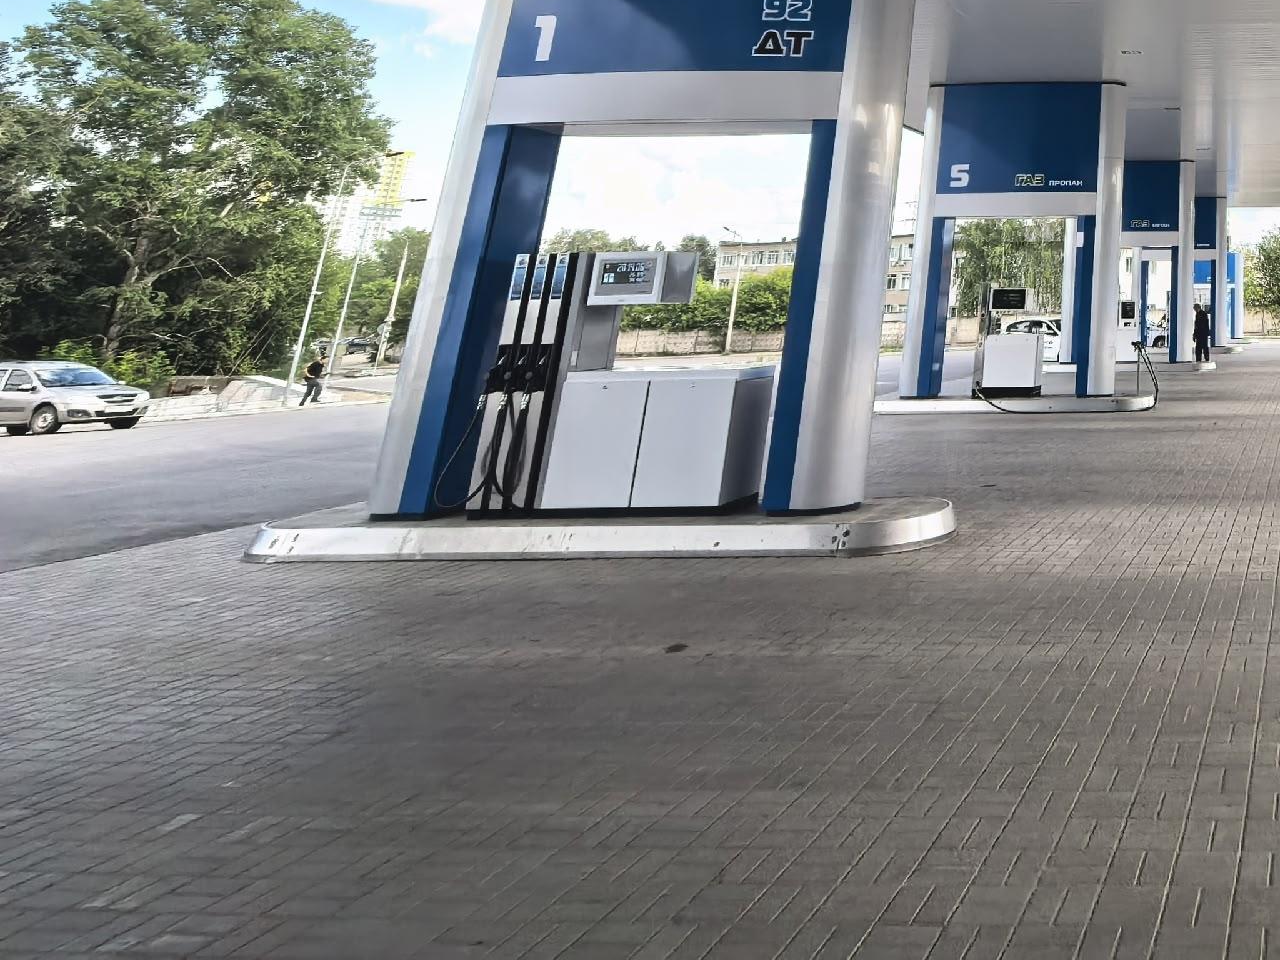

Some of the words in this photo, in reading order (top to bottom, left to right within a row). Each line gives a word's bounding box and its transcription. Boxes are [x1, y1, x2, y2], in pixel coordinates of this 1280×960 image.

[535, 15, 557, 62] 1
[752, 29, 815, 57] ДТ
[949, 163, 970, 188] 5
[1014, 173, 1045, 187] ГАЗ
[1048, 179, 1083, 187] ПРОПАН
